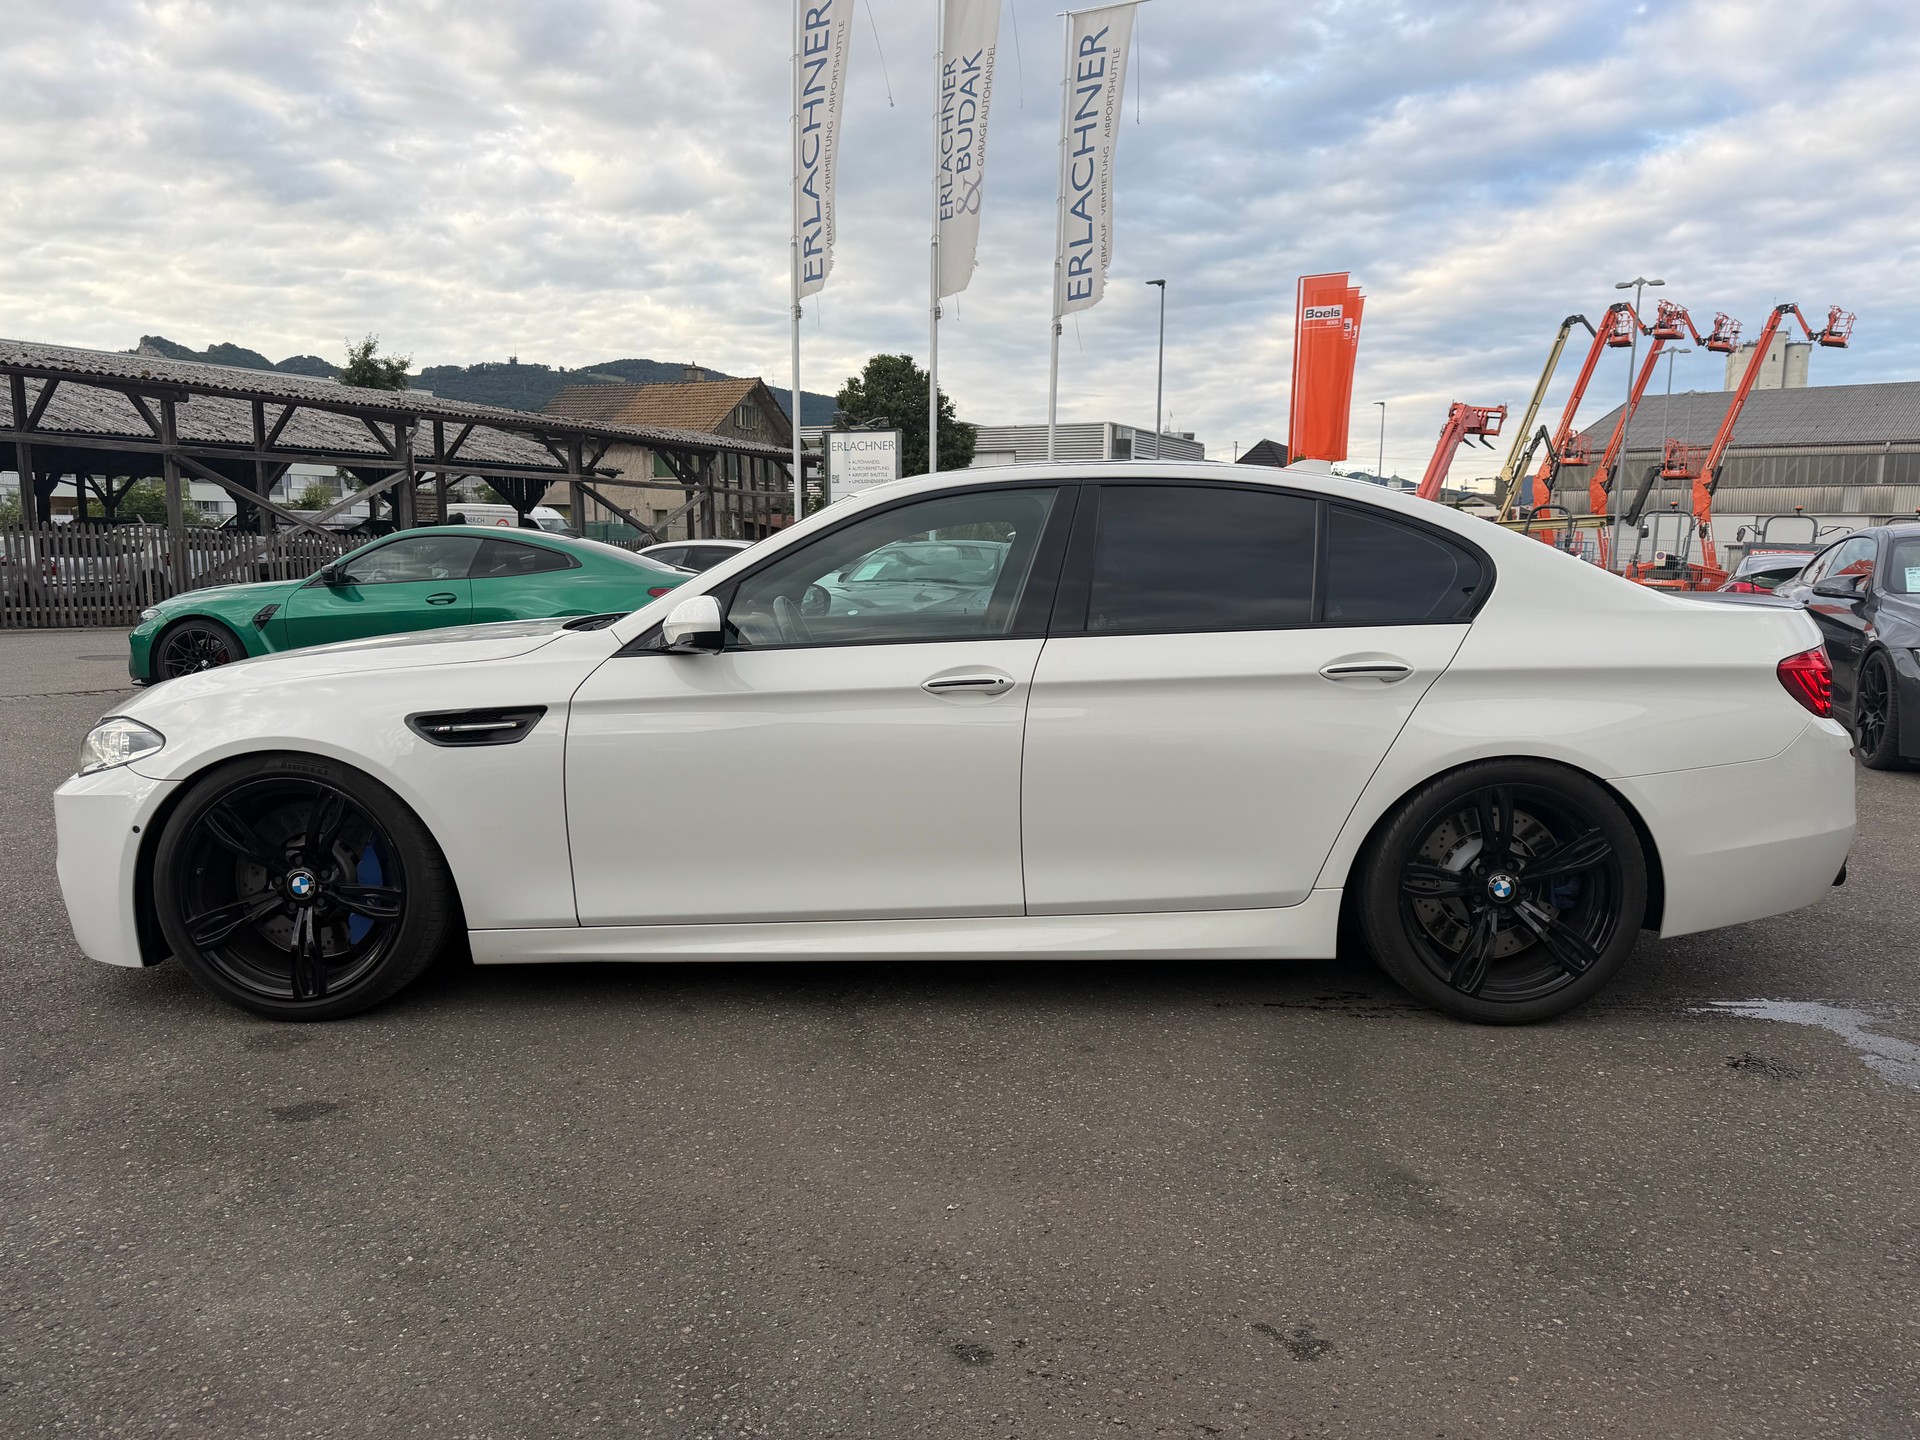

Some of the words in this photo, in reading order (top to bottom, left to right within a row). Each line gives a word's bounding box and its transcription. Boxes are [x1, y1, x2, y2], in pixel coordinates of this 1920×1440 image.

[828, 20, 846, 113] AIRPORTSHUTTLE
[980, 44, 996, 120] AUTOHANDEL
[1104, 47, 1121, 138] AIRPORTSHUTTLE
[802, 0, 832, 283] ERLACHNER
[940, 57, 957, 221] ERLACHNER
[956, 48, 984, 175] BUDAK
[976, 122, 989, 167] GARAGE
[824, 120, 834, 193] VERMIETUNG
[955, 170, 983, 215] &
[1067, 25, 1109, 301] ERLACHNER
[1100, 145, 1110, 216] VERMIETUNG
[1305, 308, 1341, 319] Boels
[831, 440, 896, 452] ERLACHNER
